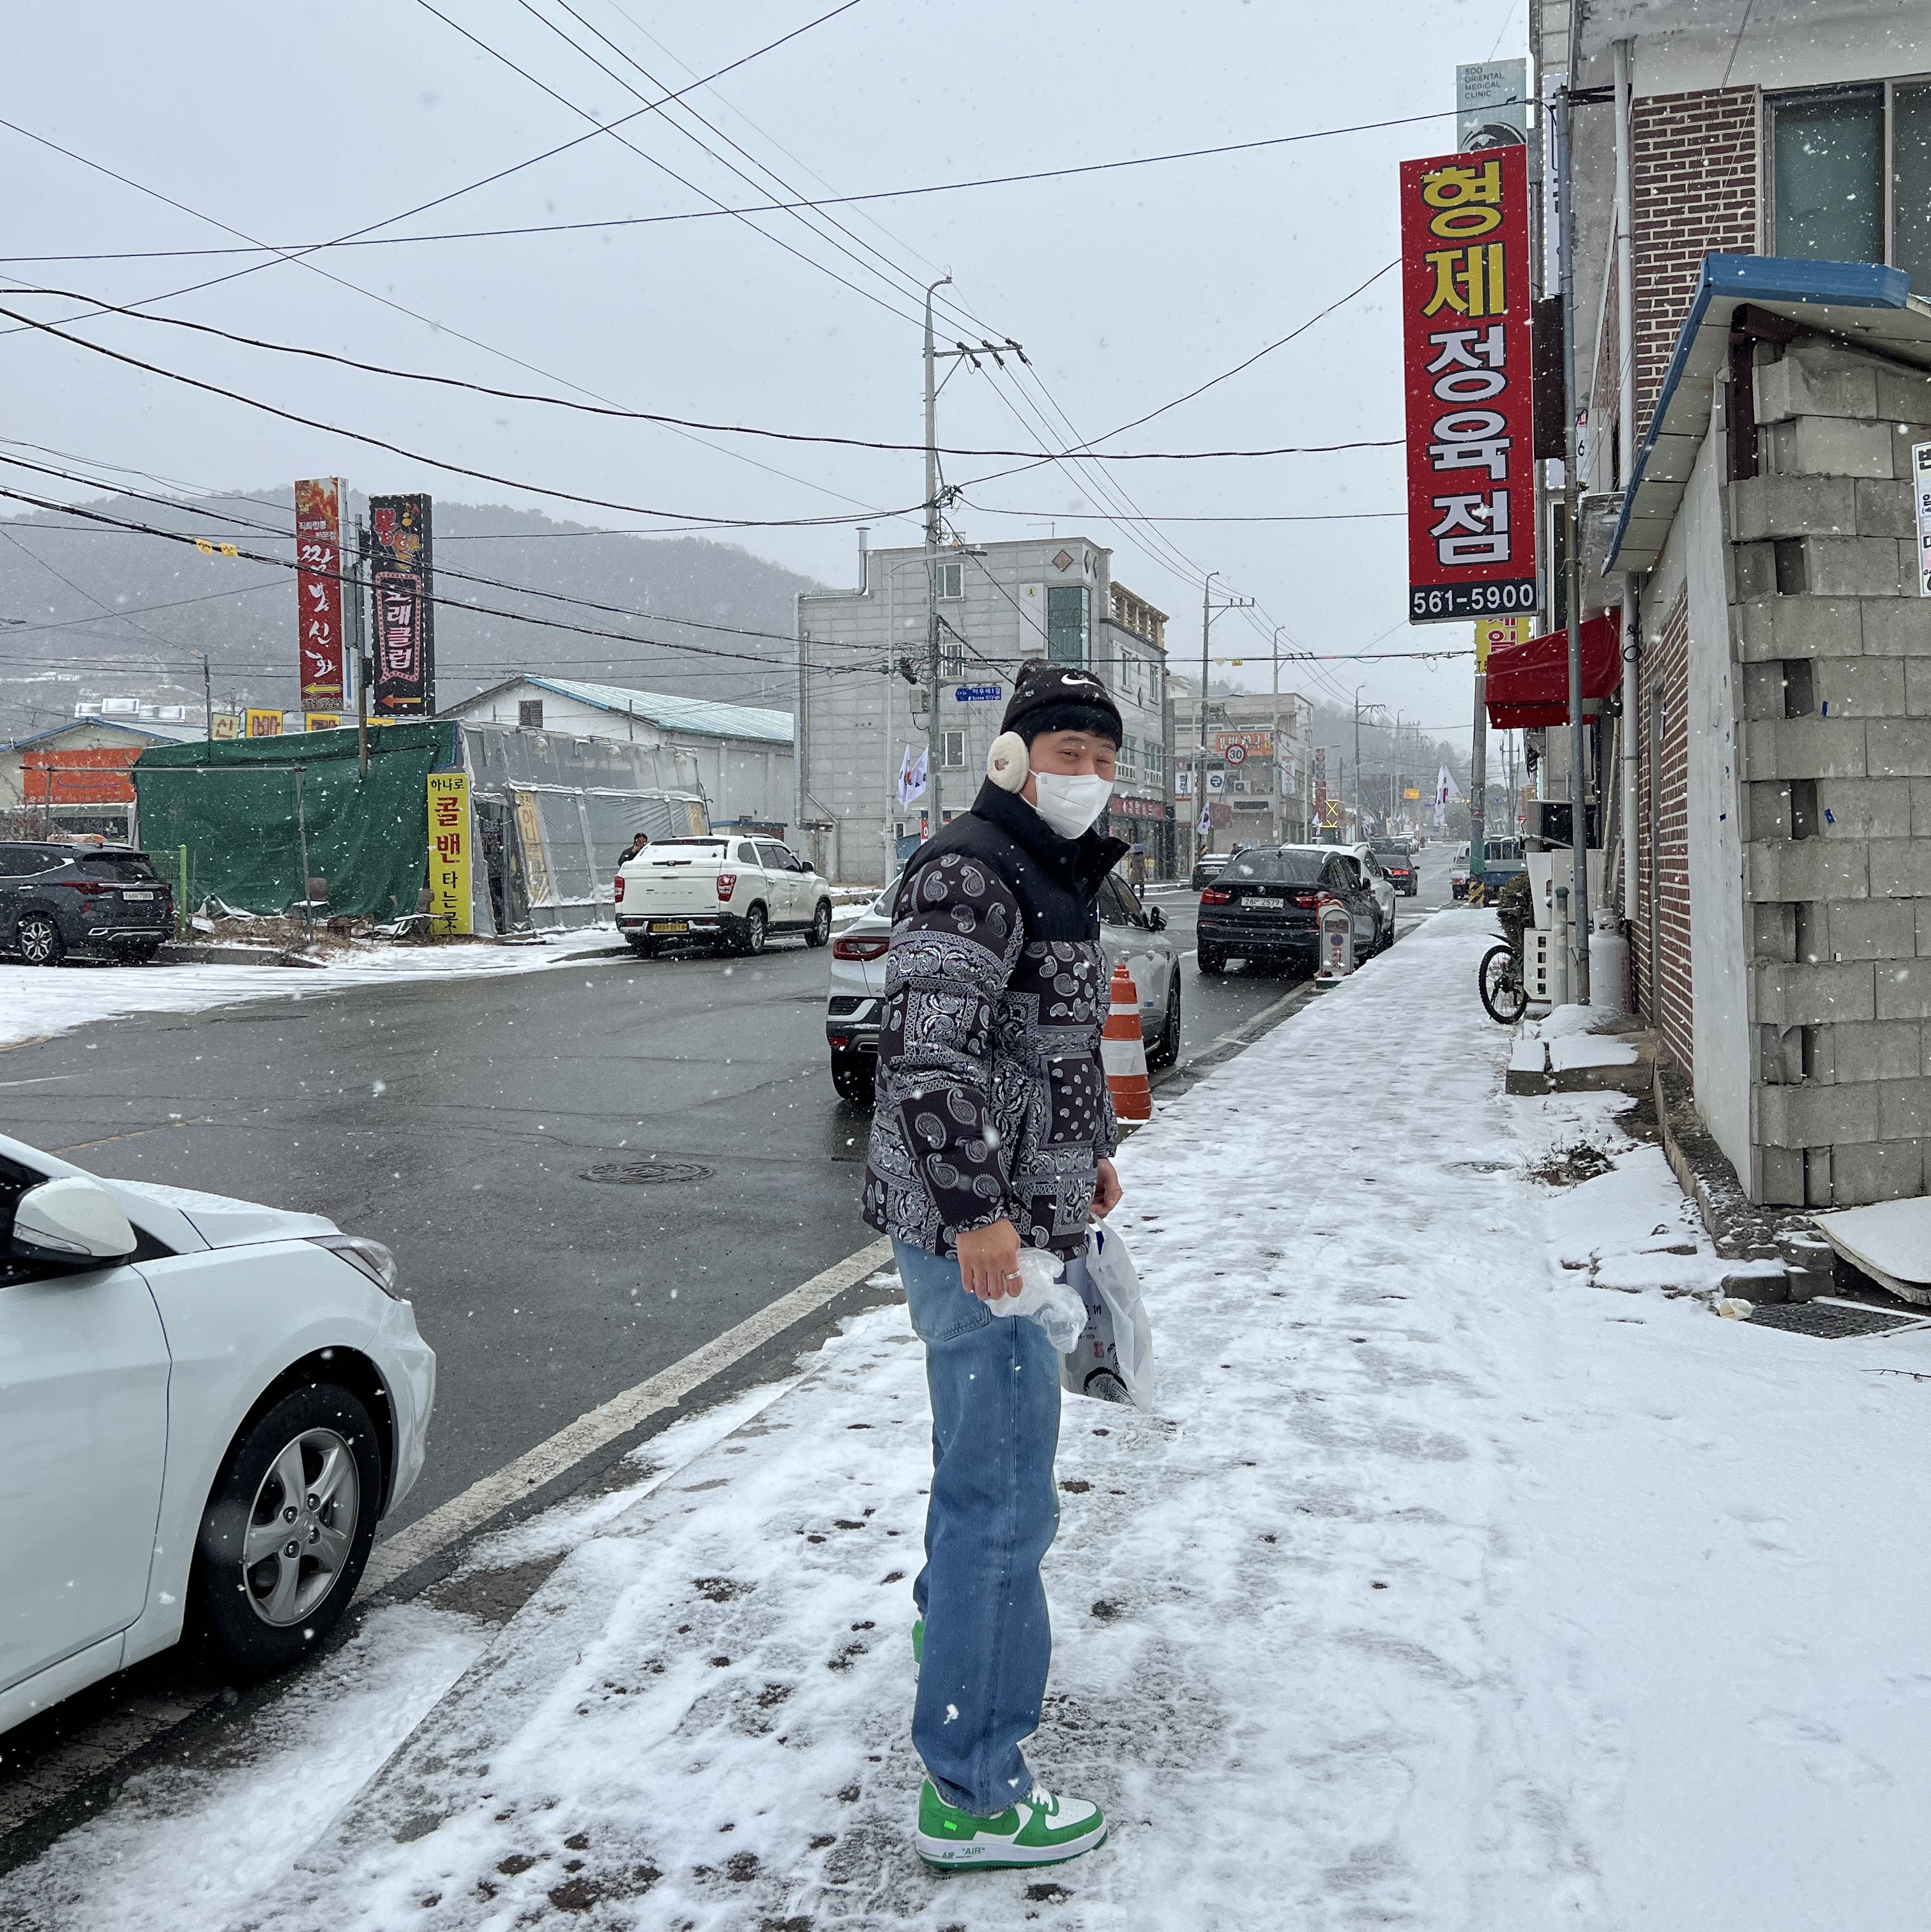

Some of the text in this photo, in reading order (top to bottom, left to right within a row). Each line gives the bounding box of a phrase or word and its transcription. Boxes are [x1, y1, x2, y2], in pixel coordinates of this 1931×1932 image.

[1465, 66, 1483, 75] SOO
[1464, 72, 1504, 84] ORIENTAL
[1465, 80, 1501, 91] MEDICAL
[1464, 89, 1492, 100] CLINIC
[1412, 583, 1534, 614] 561-5900
[1229, 749, 1242, 759] 30
[430, 778, 465, 792] 하나로
